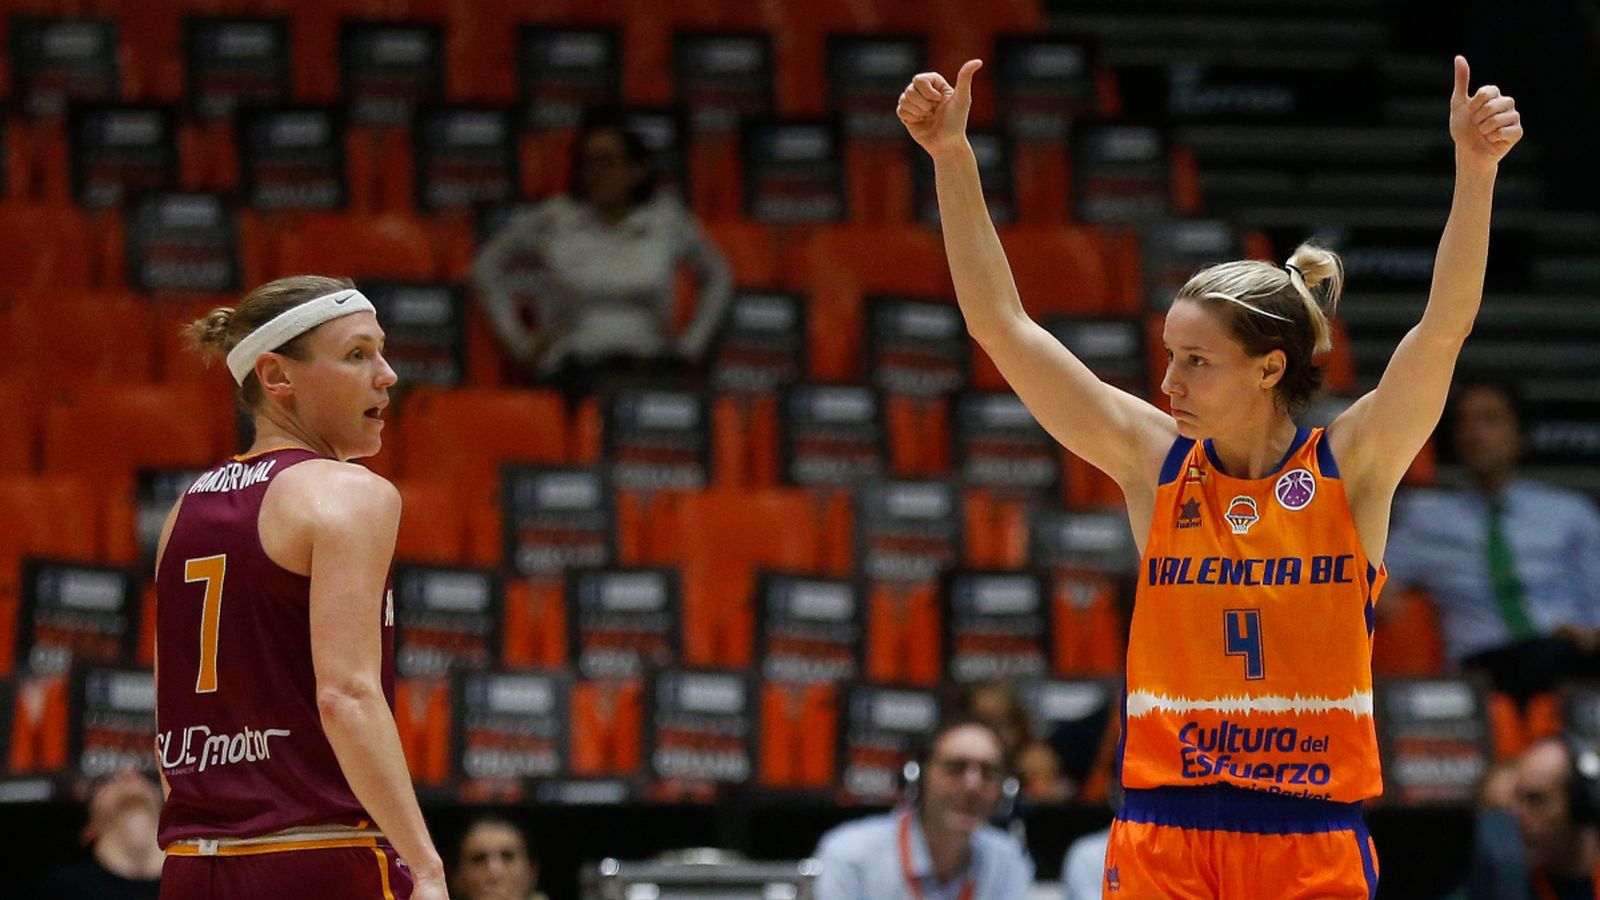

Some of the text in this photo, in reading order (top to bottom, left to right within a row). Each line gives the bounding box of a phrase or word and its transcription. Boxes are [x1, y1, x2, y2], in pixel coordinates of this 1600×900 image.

[1149, 555, 1354, 586] VALENCIA BC
[184, 553, 227, 694] 7
[1223, 608, 1266, 681] 4
[1179, 720, 1329, 753] Cultura del
[1180, 747, 1331, 785] Esfuerzo
